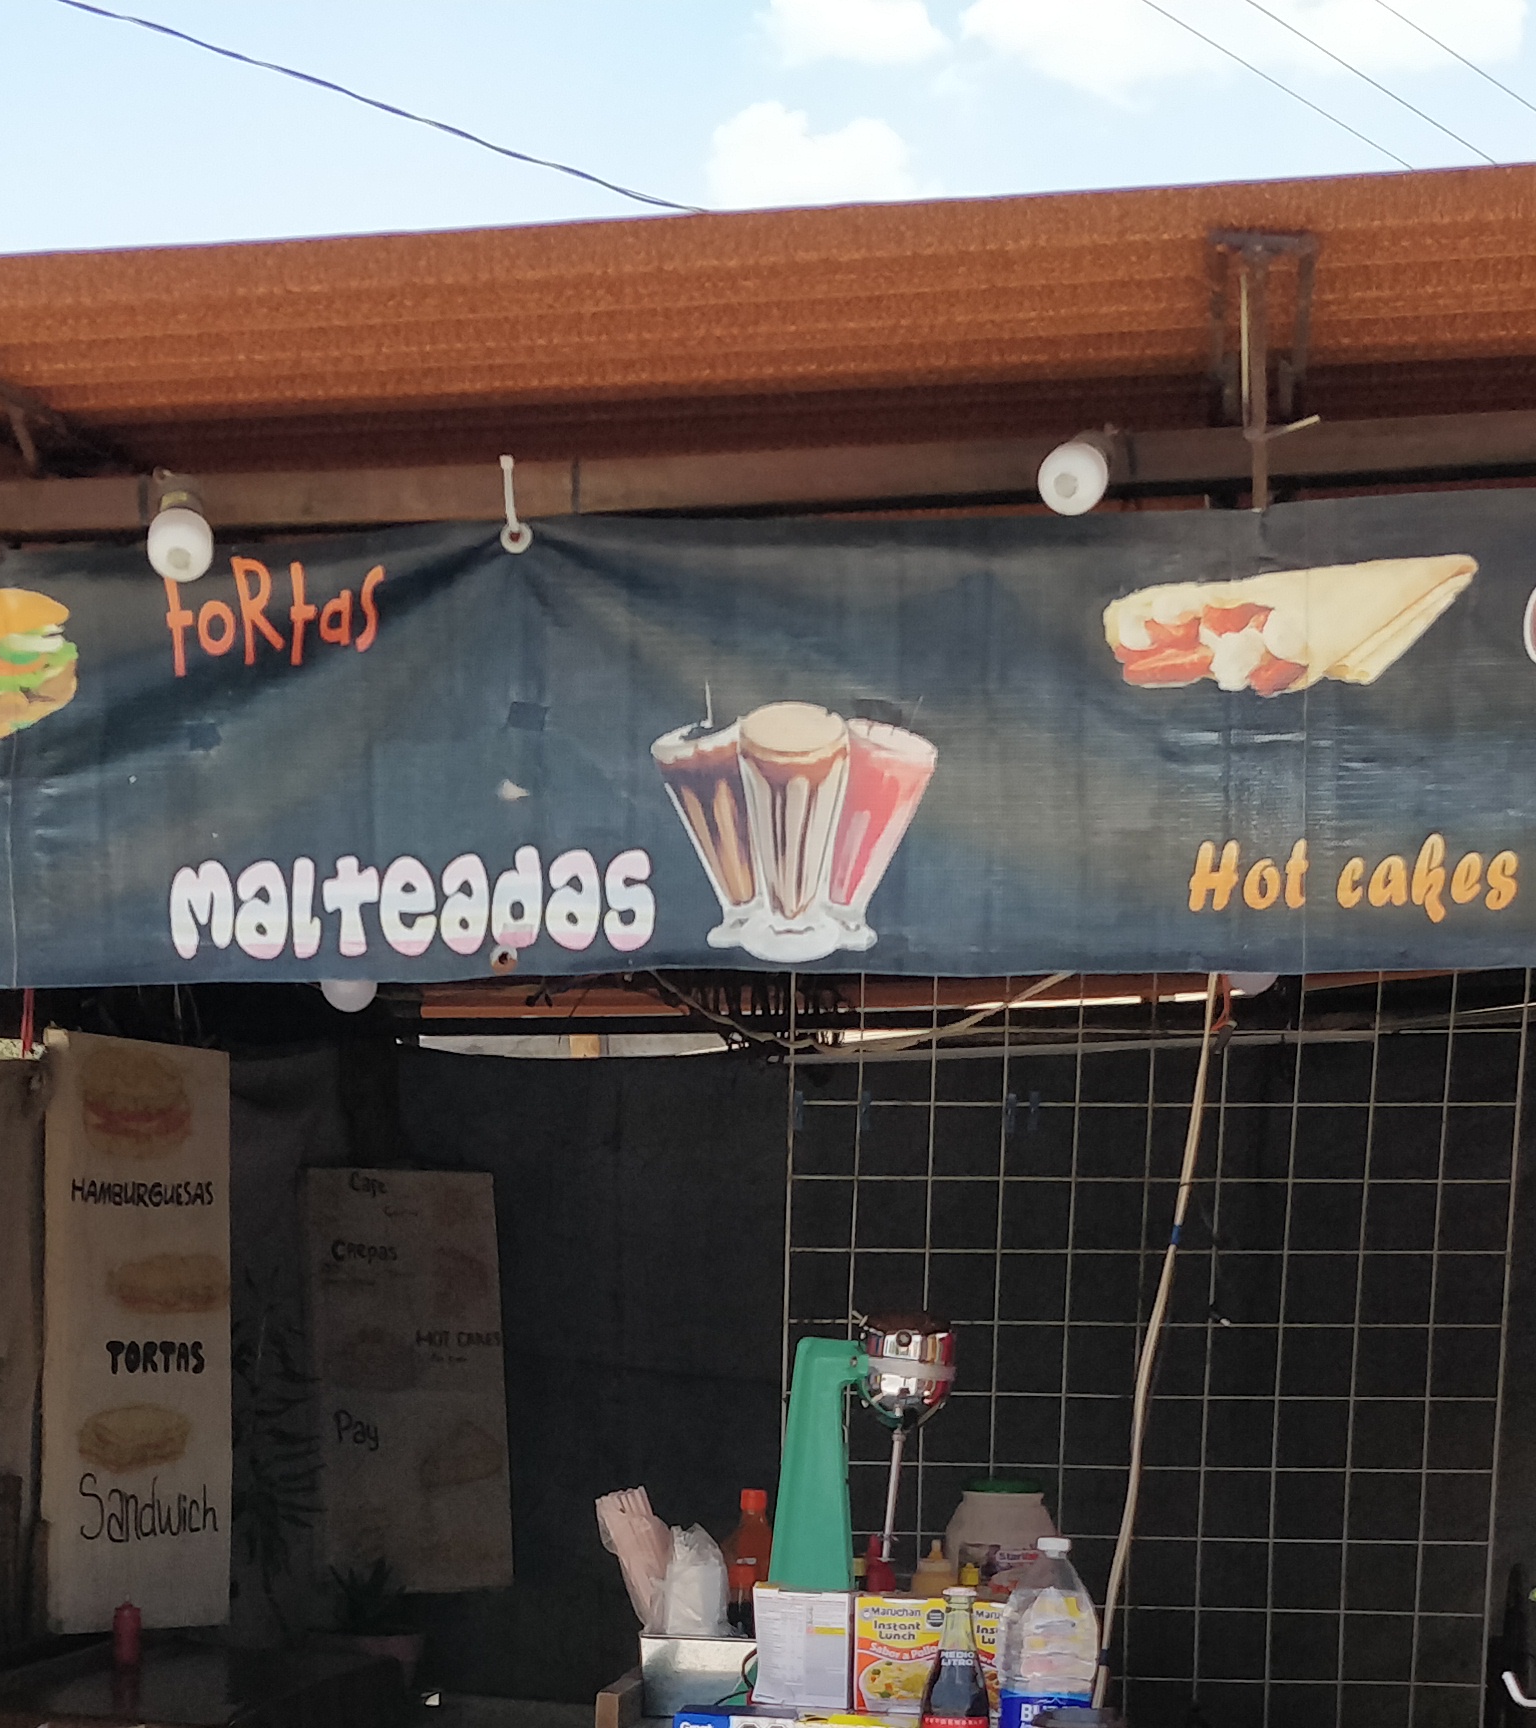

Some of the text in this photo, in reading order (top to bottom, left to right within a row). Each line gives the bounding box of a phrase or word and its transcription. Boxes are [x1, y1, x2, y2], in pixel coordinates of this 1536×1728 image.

[1187, 832, 1520, 925] Hot cakes
[70, 1177, 215, 1207] HAMBURGUESAS
[105, 1339, 206, 1375] TORTAS
[333, 1408, 380, 1451] Pay
[78, 1472, 219, 1543] Sandwich
[871, 1607, 922, 1617] Maruchan
[873, 1620, 922, 1631] Instant
[878, 1630, 916, 1641] Lunch
[869, 1641, 901, 1660] Sabor
[940, 1650, 976, 1660] MEDIO
[940, 1658, 974, 1667] LITRO
